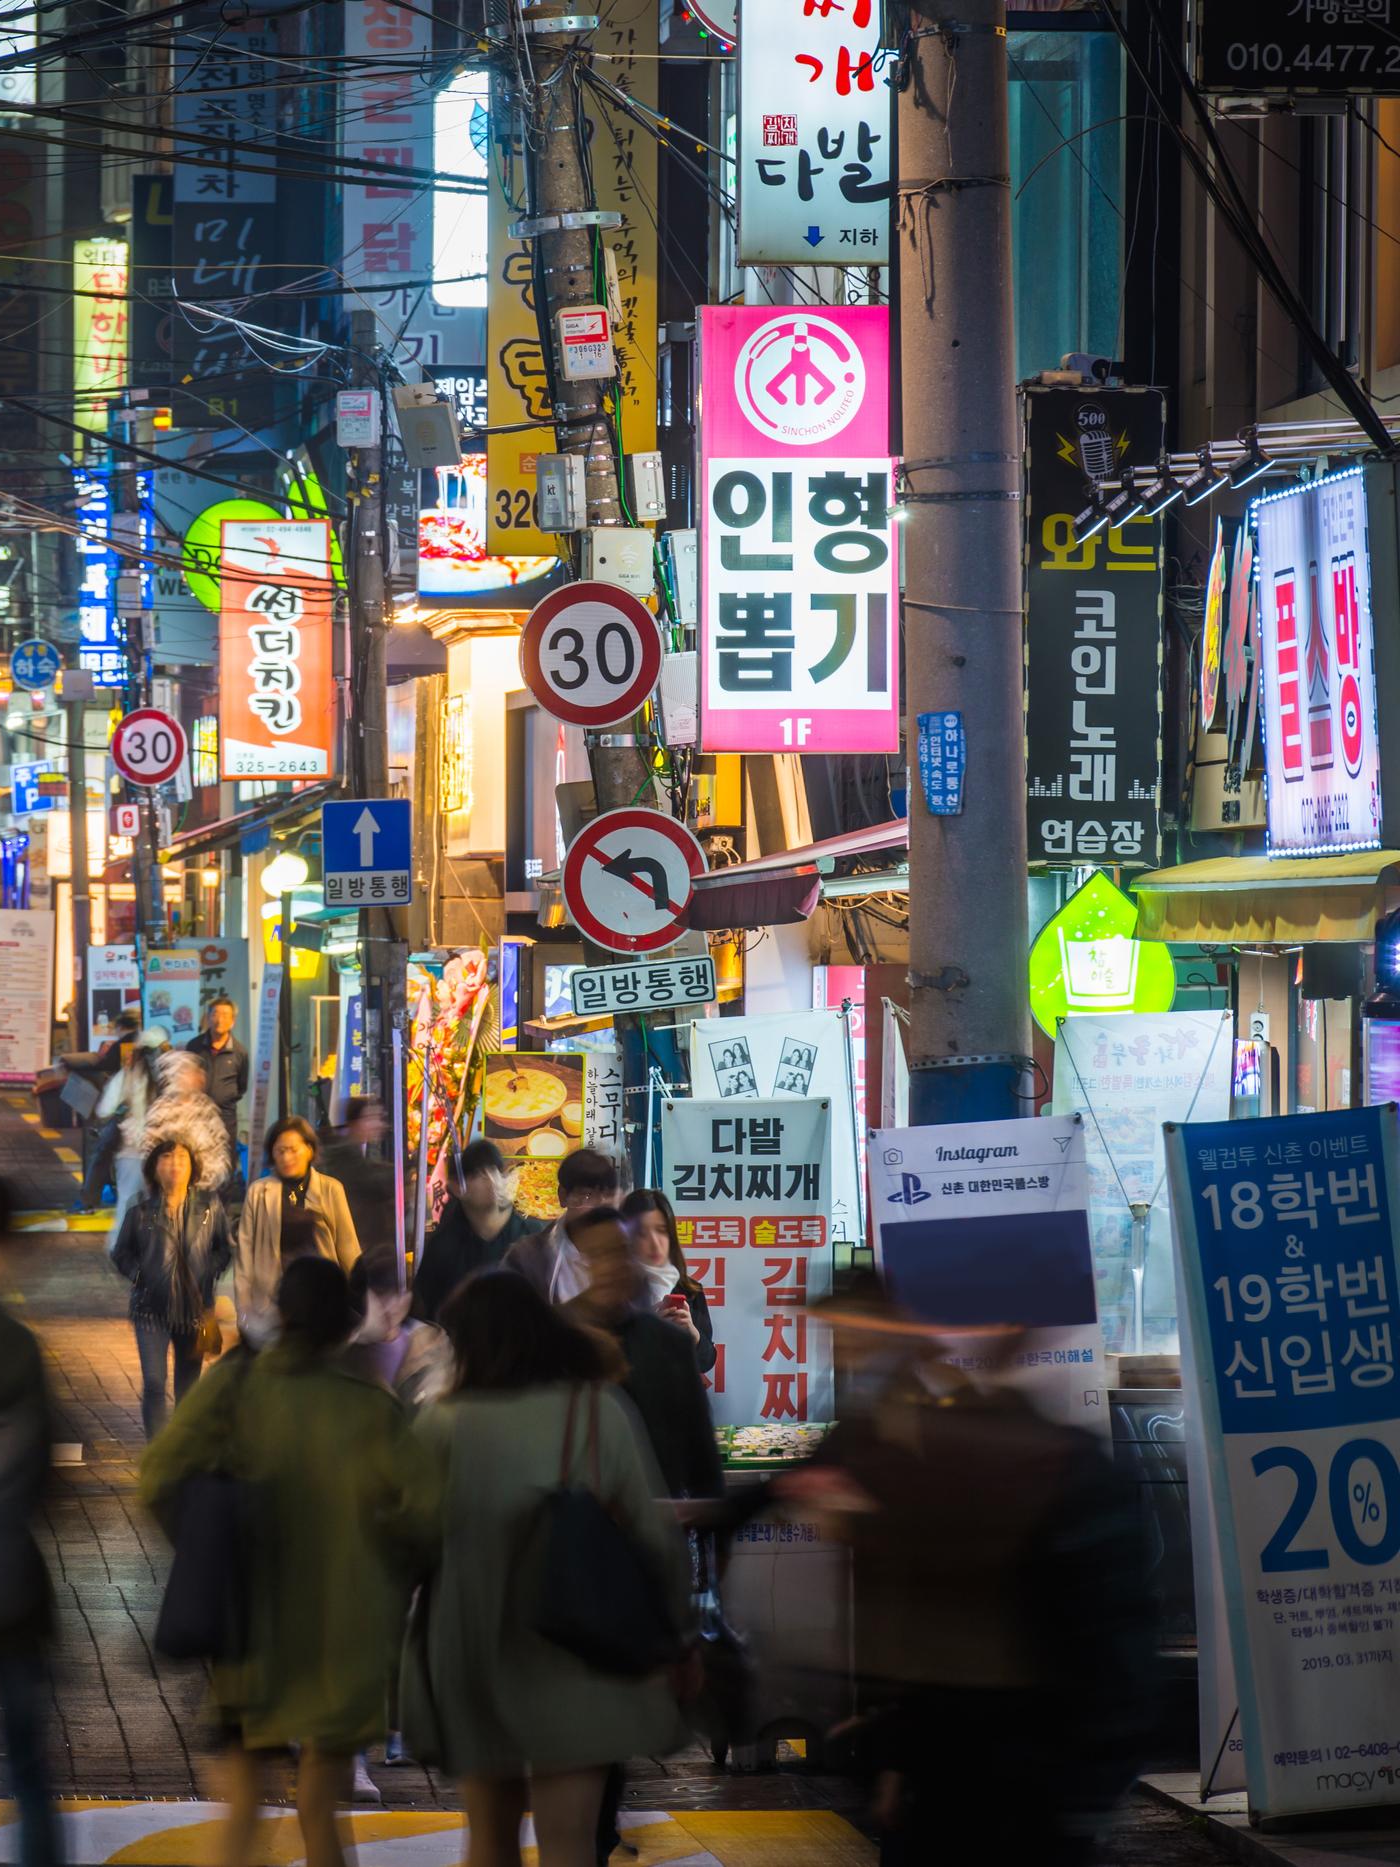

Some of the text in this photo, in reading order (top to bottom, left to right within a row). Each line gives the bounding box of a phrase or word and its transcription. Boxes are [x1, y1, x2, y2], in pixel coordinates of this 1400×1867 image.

[756, 121, 892, 203] 다발
[840, 228, 879, 246] 지하
[781, 389, 856, 437] SINCHON NOLITEO
[1078, 411, 1106, 427] 500
[713, 470, 888, 574] 인형
[548, 622, 635, 690] 30
[715, 592, 888, 692] 뽑기
[126, 730, 172, 765] 30
[779, 716, 812, 746] 1F
[236, 760, 319, 773] 325-2643
[1041, 819, 1145, 856] 연습장
[326, 875, 409, 900] 일방통행
[577, 961, 712, 1010] 일방통행
[586, 1067, 599, 1121] 하늘아래
[598, 1067, 622, 1146] 스무디
[711, 1117, 785, 1156] 다발
[935, 1143, 1019, 1164] Instagram
[1197, 1135, 1369, 1171] 웰컴투 신촌 이벤트
[672, 1163, 821, 1202] 김치찌개
[941, 1181, 966, 1197] 신촌
[1201, 1163, 1381, 1231] 18학번
[753, 1218, 822, 1246] 술도둑
[1284, 1234, 1306, 1259] &
[1213, 1255, 1390, 1323] 19학번
[1224, 1322, 1395, 1399] 신입생
[1273, 1749, 1322, 1767] 예약문의
